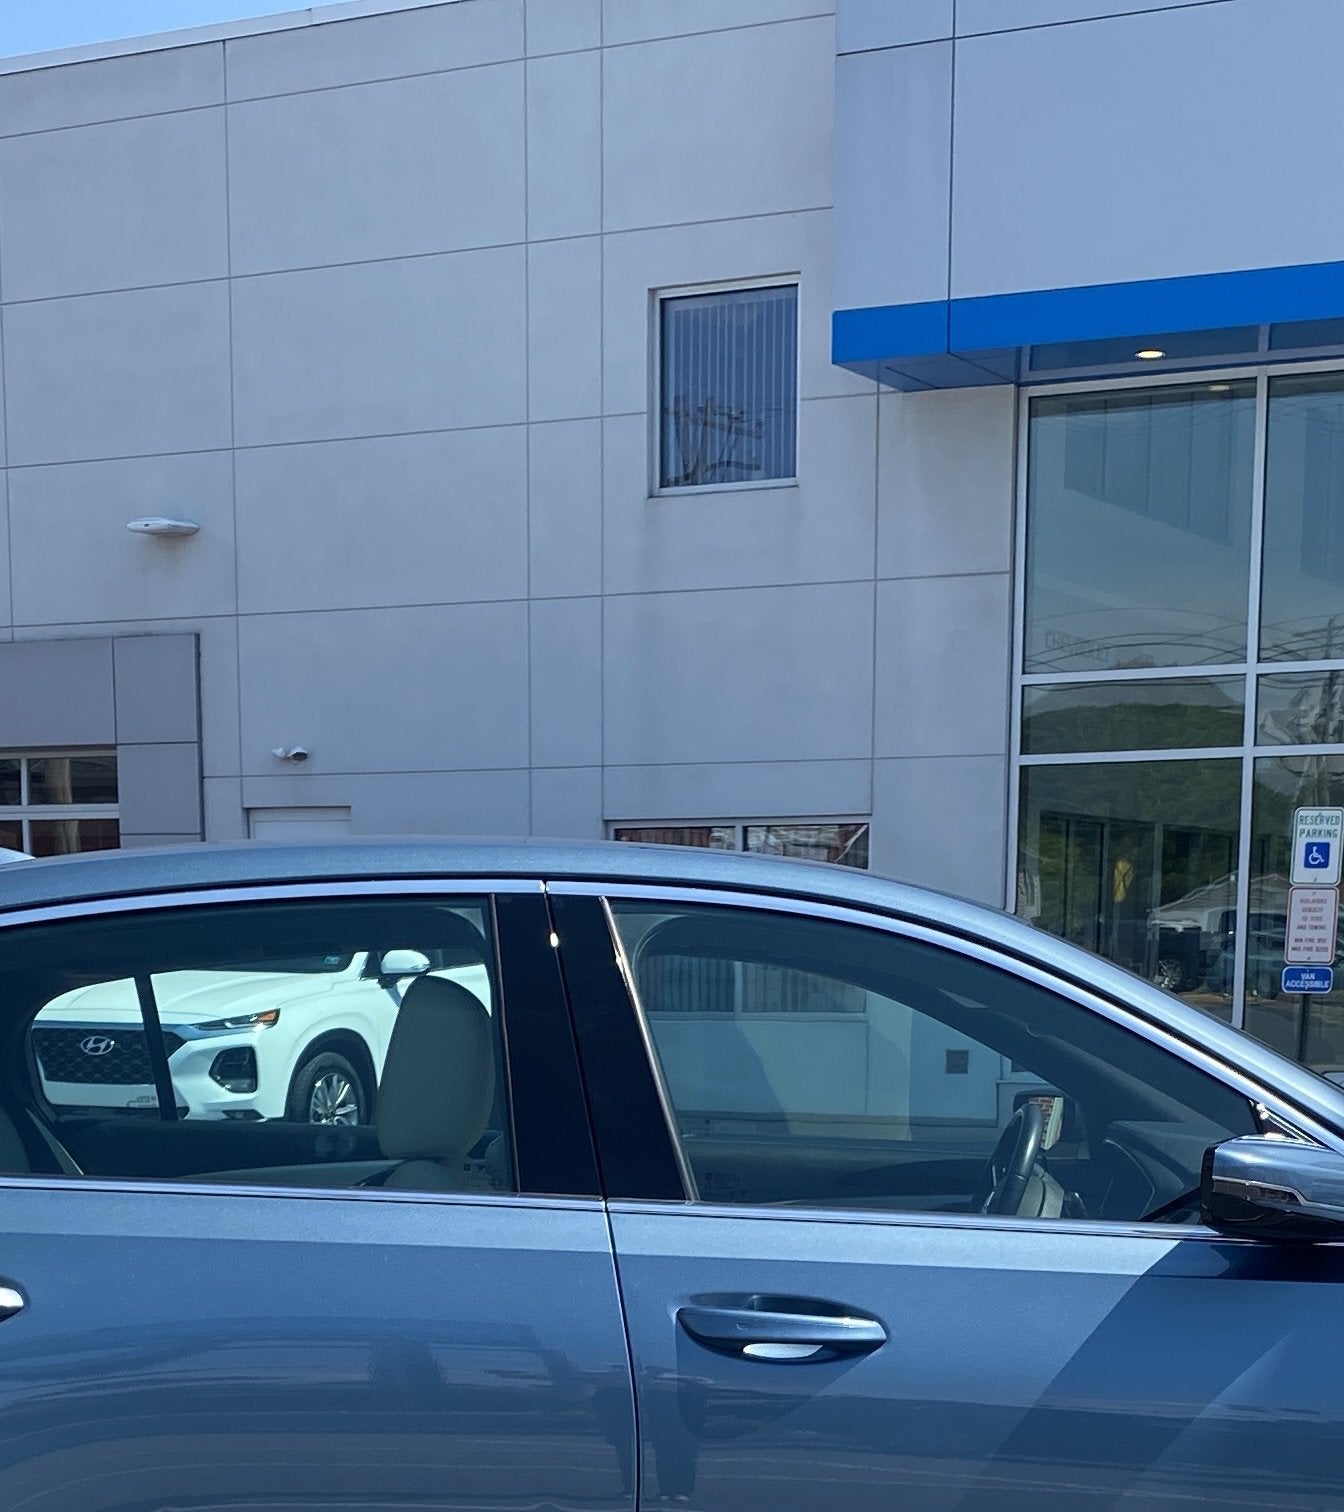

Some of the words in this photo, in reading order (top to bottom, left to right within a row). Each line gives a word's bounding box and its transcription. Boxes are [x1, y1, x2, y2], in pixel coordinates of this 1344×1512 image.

[1298, 815, 1340, 825] RESERVED
[1298, 828, 1338, 838] PARKING
[1300, 972, 1316, 980] VAN
[1285, 980, 1330, 988] ACCESSIBLE
